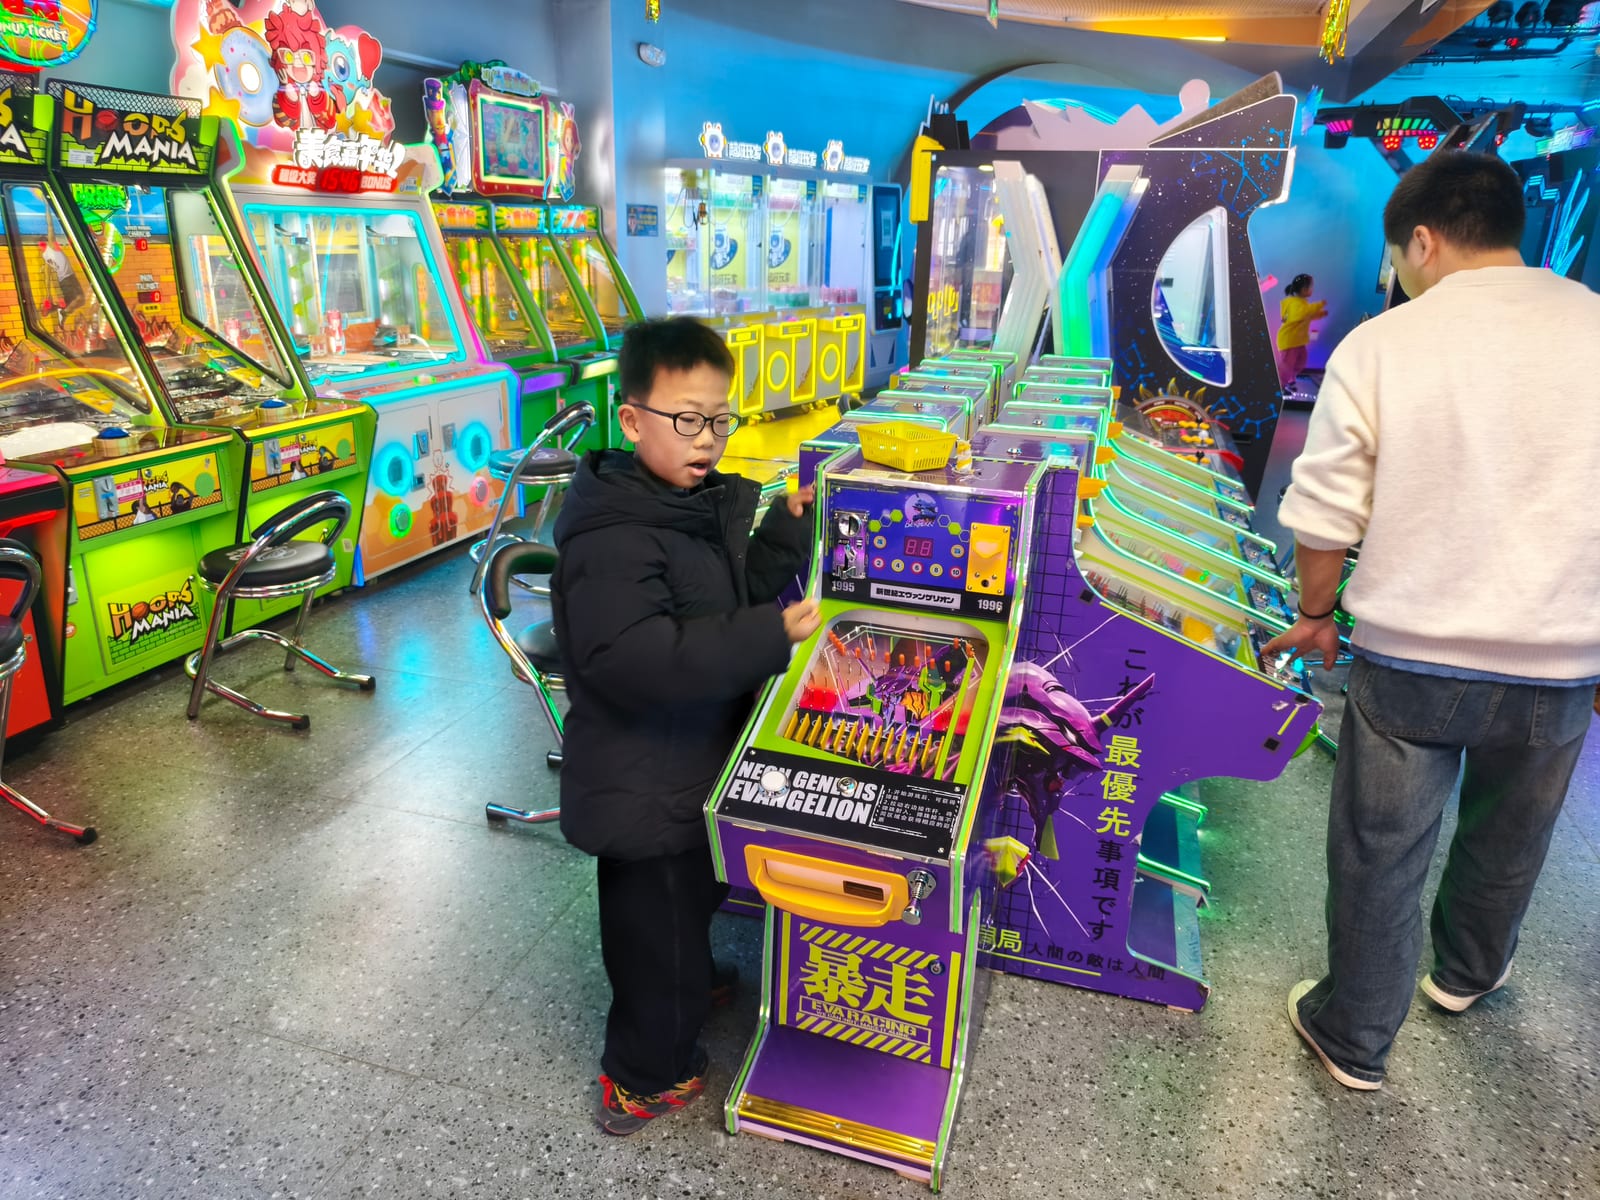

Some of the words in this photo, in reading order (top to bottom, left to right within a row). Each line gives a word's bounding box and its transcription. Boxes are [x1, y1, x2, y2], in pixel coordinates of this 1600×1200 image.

[0, 23, 25, 35] NUS
[28, 24, 68, 42] TICKET
[101, 131, 197, 166] MANIA
[361, 175, 393, 190] BONUS
[832, 580, 855, 593] 1995
[108, 578, 193, 639] HOOPS
[978, 599, 1003, 613] 1996
[131, 604, 195, 641] MANIA
[737, 760, 793, 782] NEN
[800, 943, 935, 1026] 暴走
[811, 1000, 845, 1019] EVA
[847, 1011, 917, 1037] RACING
